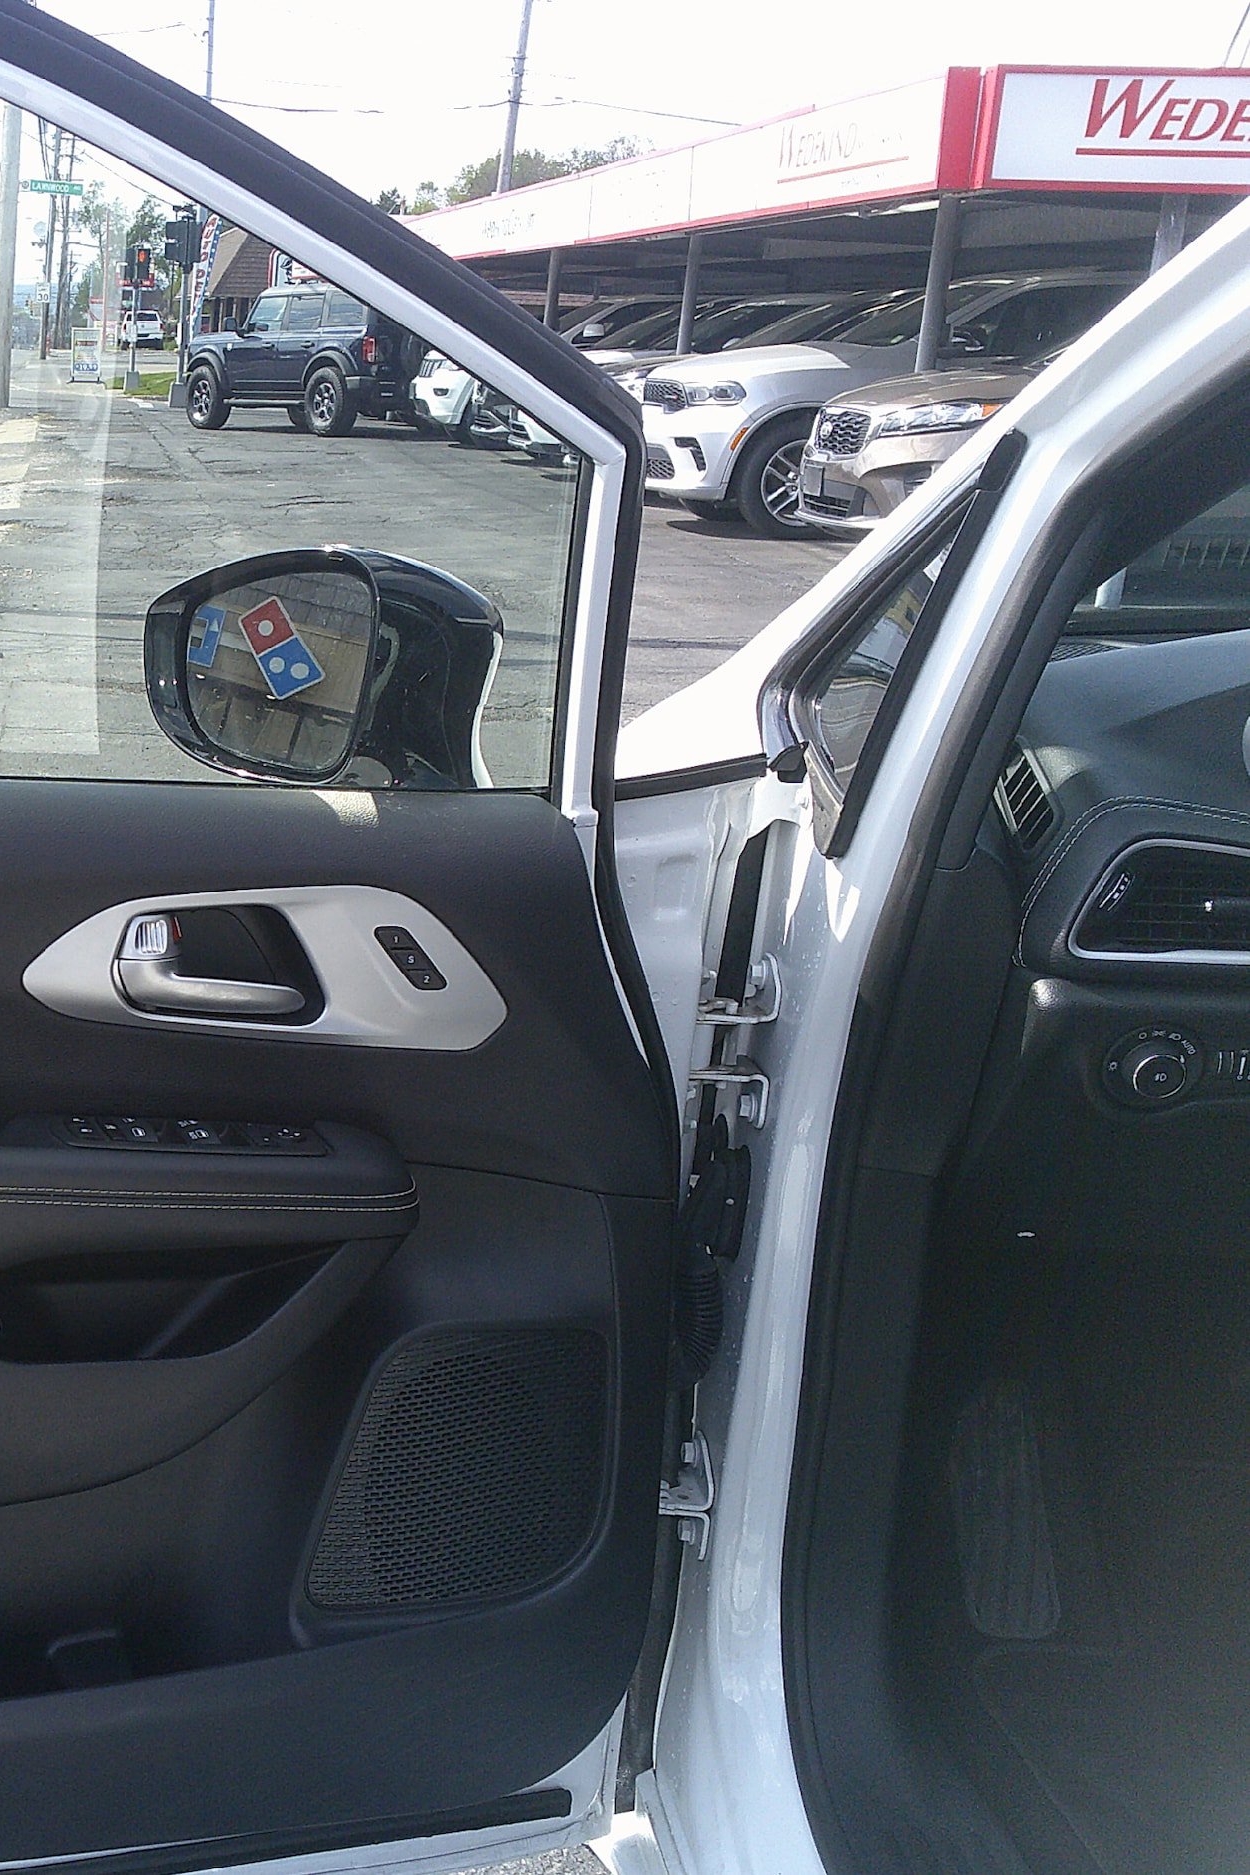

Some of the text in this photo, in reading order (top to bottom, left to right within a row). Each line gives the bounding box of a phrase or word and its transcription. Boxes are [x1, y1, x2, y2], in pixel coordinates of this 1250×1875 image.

[1084, 79, 1250, 141] WEDE
[37, 293, 48, 302] 30
[407, 955, 414, 963] S
[423, 975, 430, 983] 2
[1181, 1040, 1196, 1055] AUTO
